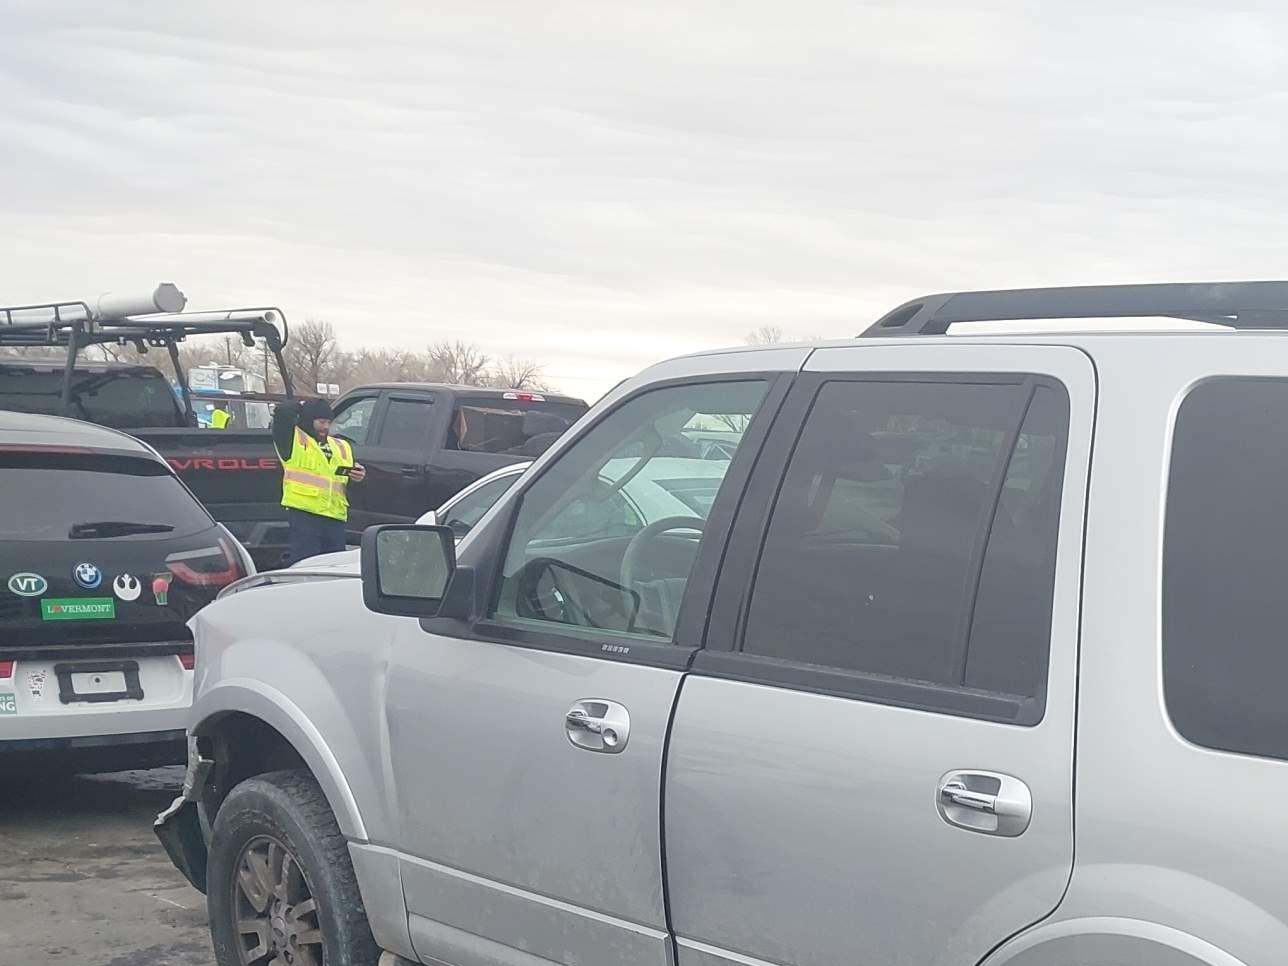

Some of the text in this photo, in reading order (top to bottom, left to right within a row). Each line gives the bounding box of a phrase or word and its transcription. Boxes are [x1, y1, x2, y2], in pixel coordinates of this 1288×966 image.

[166, 457, 280, 469] VROLE
[16, 578, 38, 590] VT
[0, 701, 15, 711] NG
